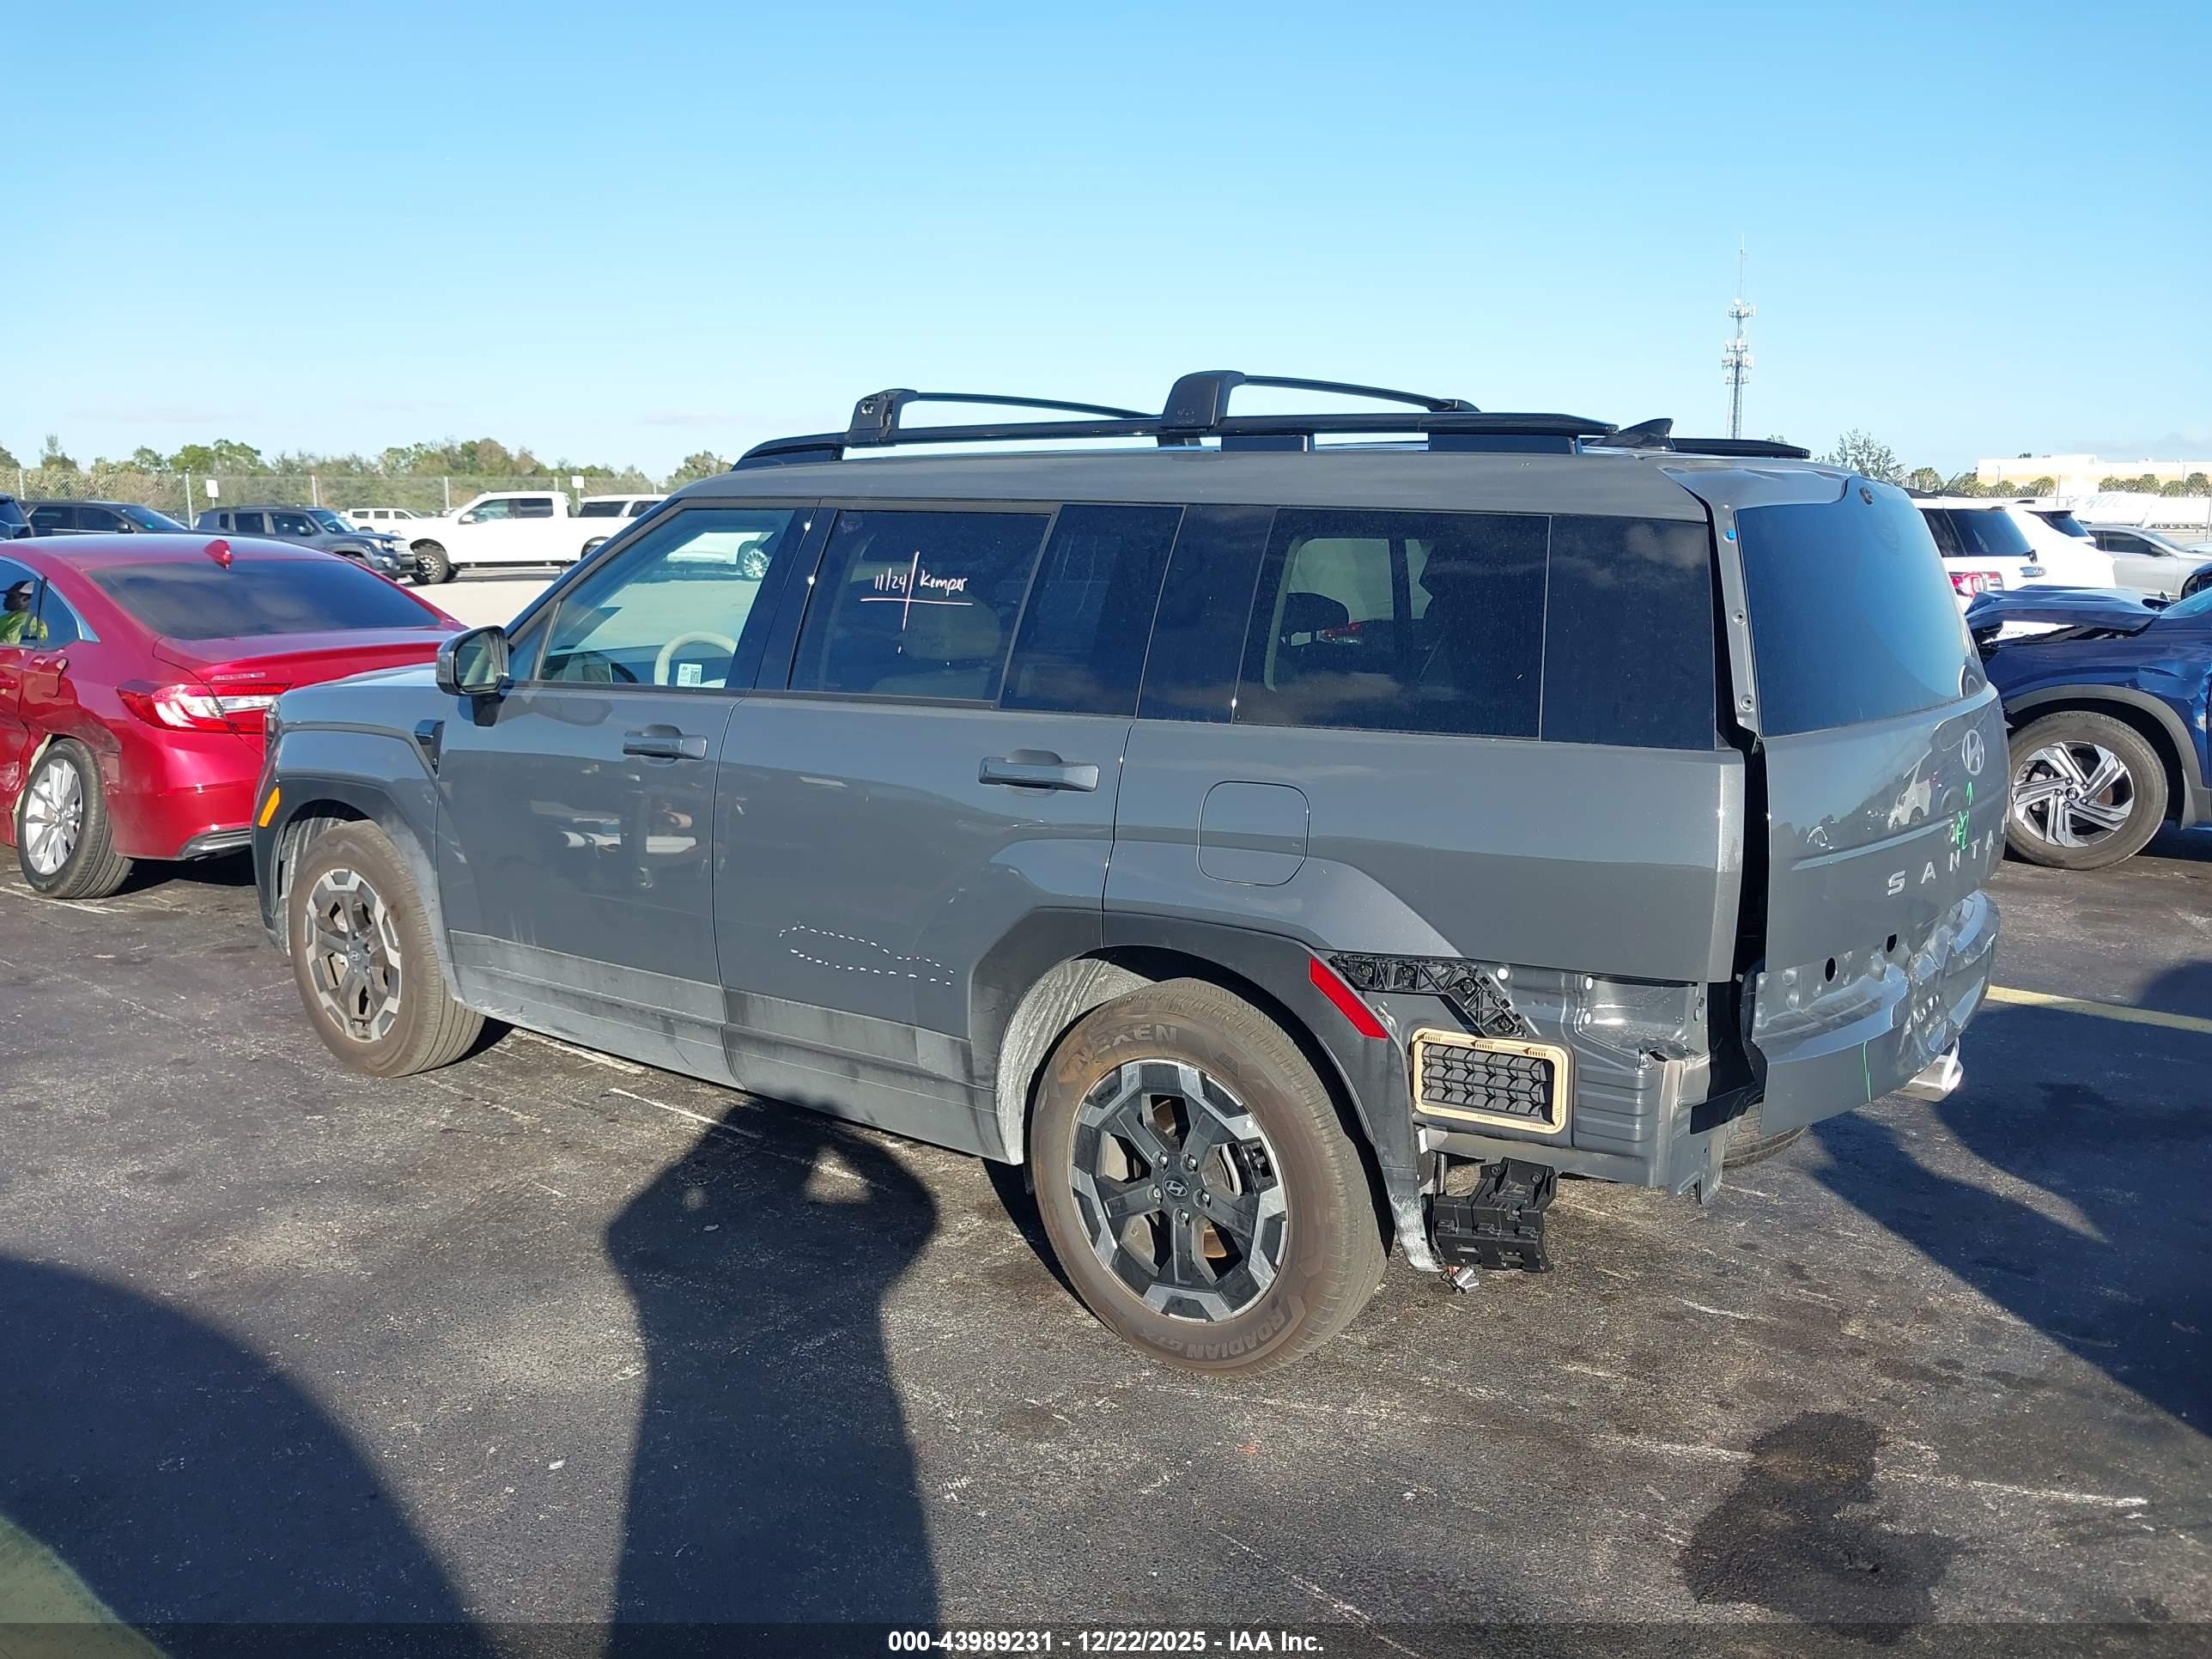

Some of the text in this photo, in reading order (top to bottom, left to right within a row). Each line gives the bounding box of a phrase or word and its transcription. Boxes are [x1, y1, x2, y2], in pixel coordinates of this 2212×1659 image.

[874, 567, 969, 598] 11/24 Kemper
[1887, 829, 1995, 896] SANTA
[1070, 1022, 1178, 1072] NEXEN
[1185, 1307, 1287, 1361] ROADIAN
